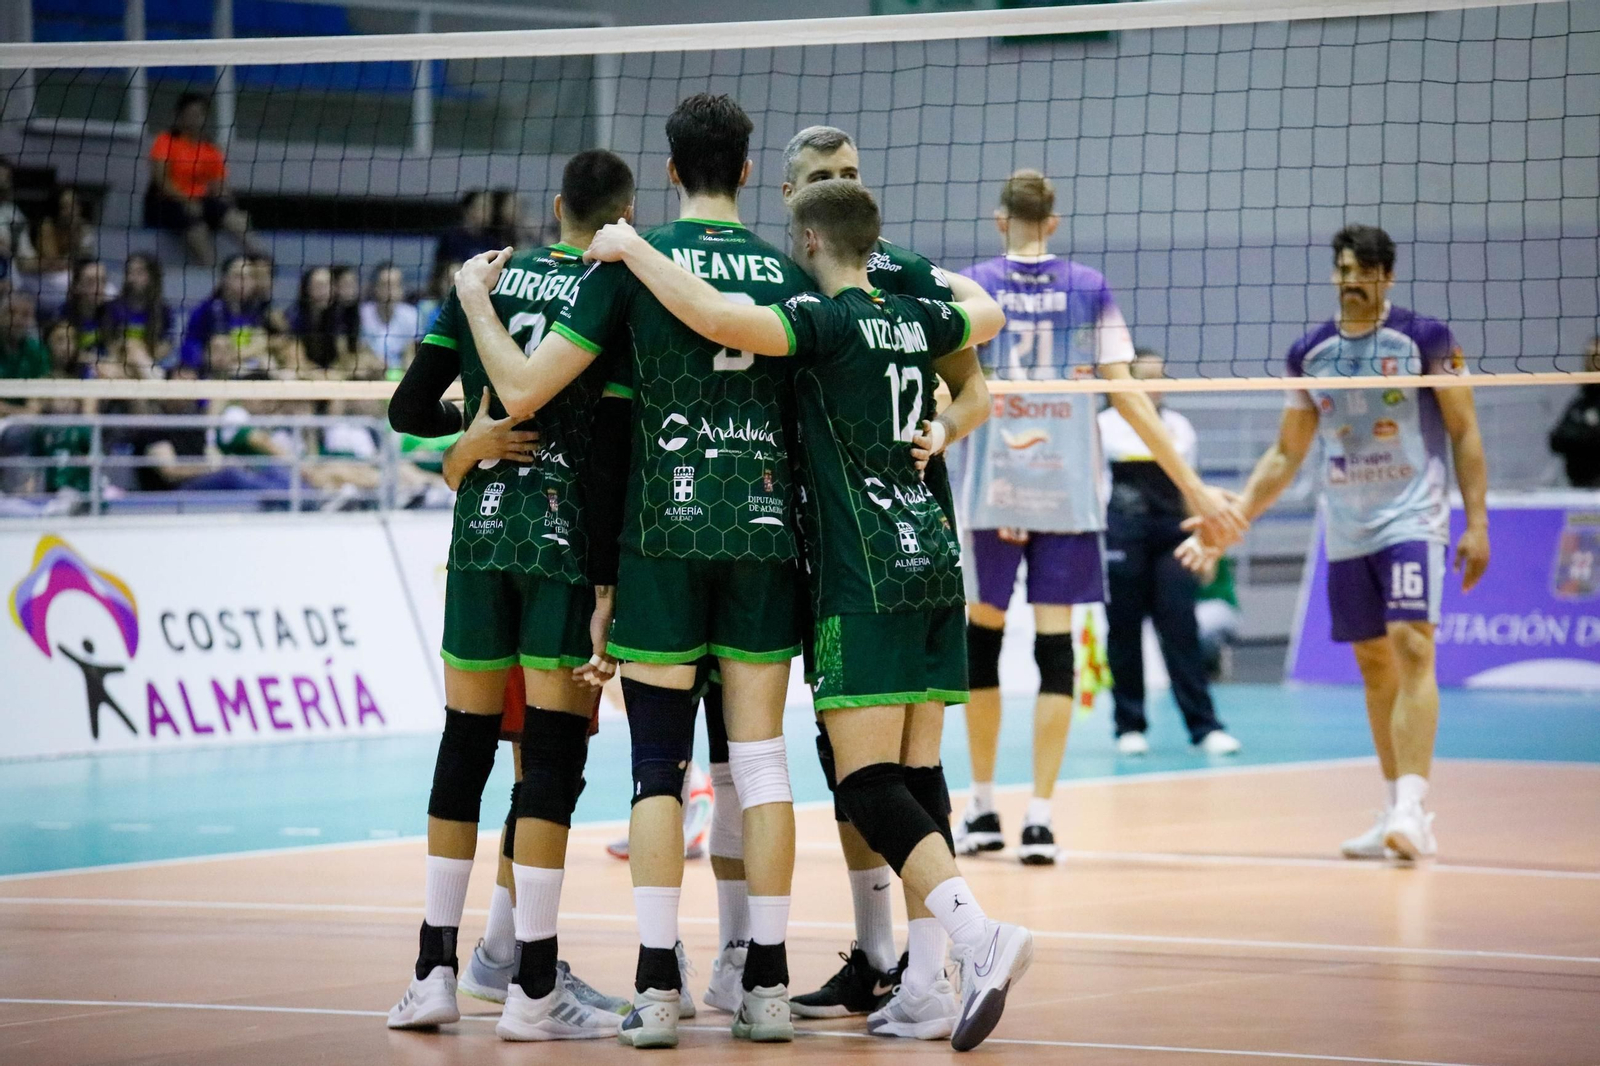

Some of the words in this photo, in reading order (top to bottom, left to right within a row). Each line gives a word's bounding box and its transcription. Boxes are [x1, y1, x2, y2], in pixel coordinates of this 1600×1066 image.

[671, 247, 784, 284] NEAVES
[884, 362, 924, 442] 12
[697, 416, 778, 448] Andalucía
[468, 518, 504, 529] ALMERÍA
[664, 505, 703, 516] ALMERÍA
[748, 504, 760, 512] DE
[894, 555, 931, 568] ALMERÍA
[1390, 561, 1424, 600] 16
[159, 610, 298, 652] COSTA
[303, 605, 356, 647] DE
[146, 657, 387, 737] ALMERÍA
